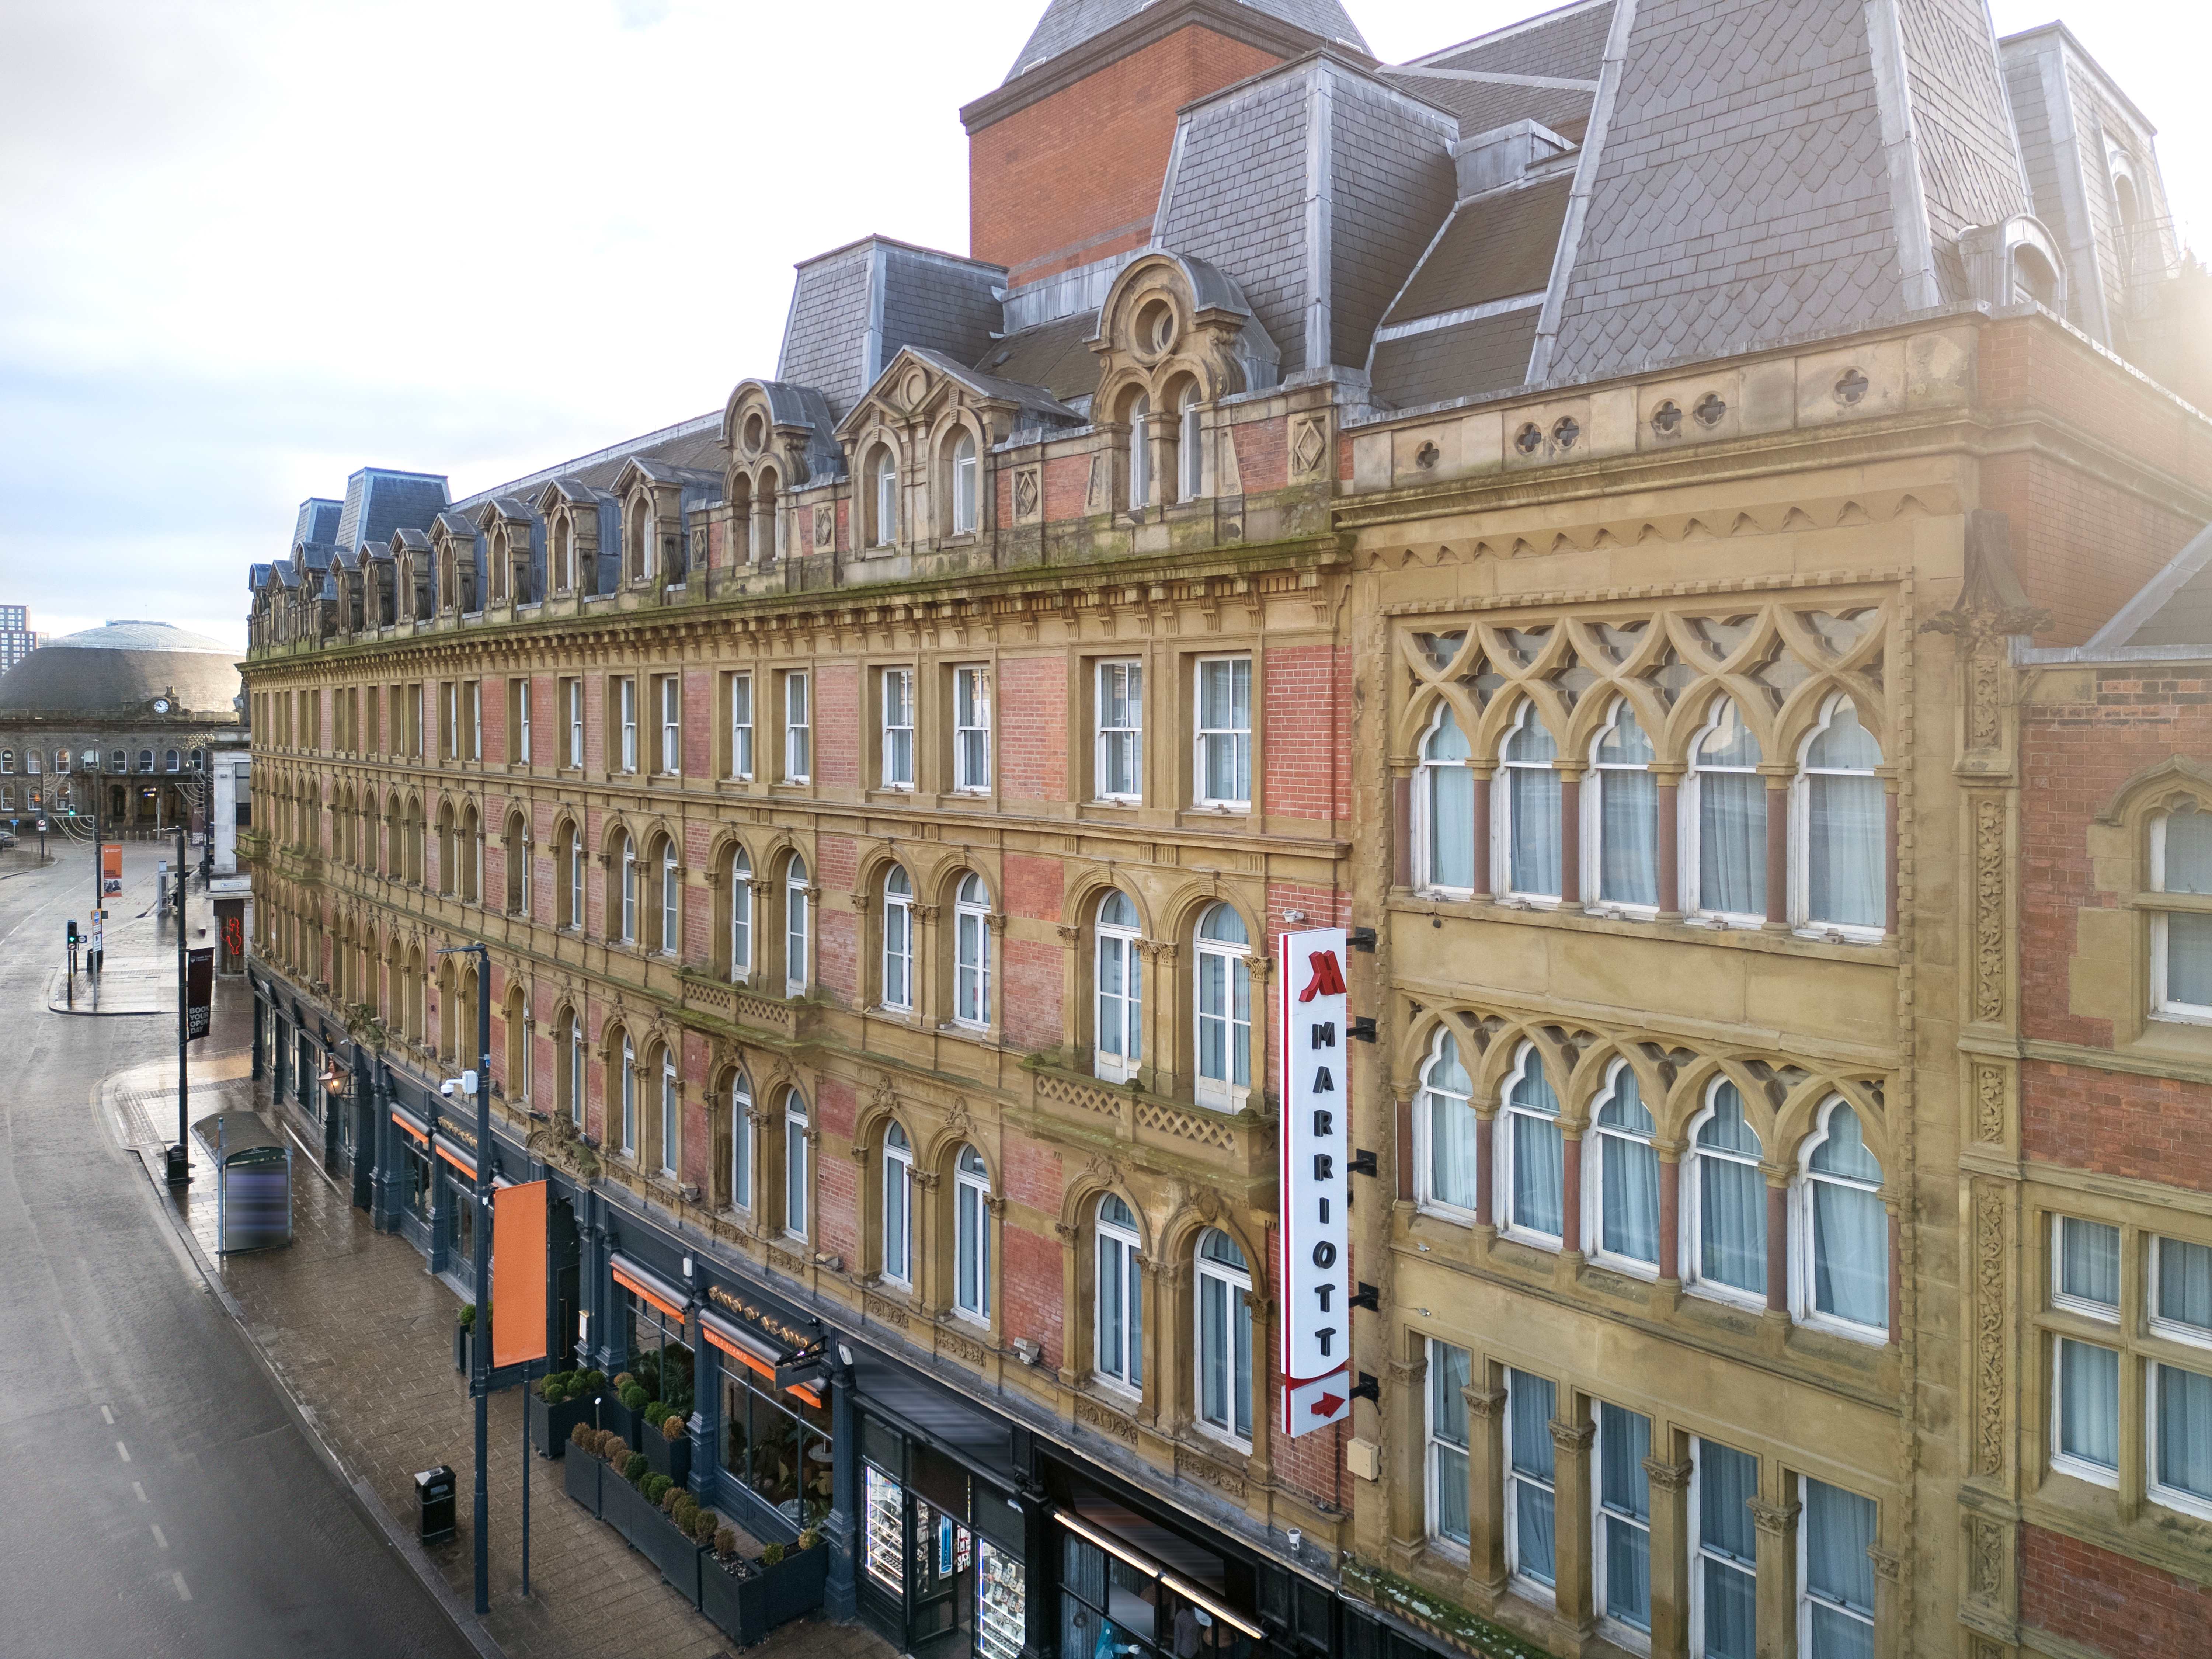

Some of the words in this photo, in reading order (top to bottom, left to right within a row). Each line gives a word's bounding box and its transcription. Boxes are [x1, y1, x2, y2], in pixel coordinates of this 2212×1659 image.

[189, 1005, 209, 1014] BOOK
[190, 1012, 208, 1020] YOUR
[190, 1019, 208, 1027] OPEN
[191, 1026, 203, 1034] DAY
[1312, 1021, 1336, 1357] MARRIOTT
[705, 1331, 718, 1342] GINO
